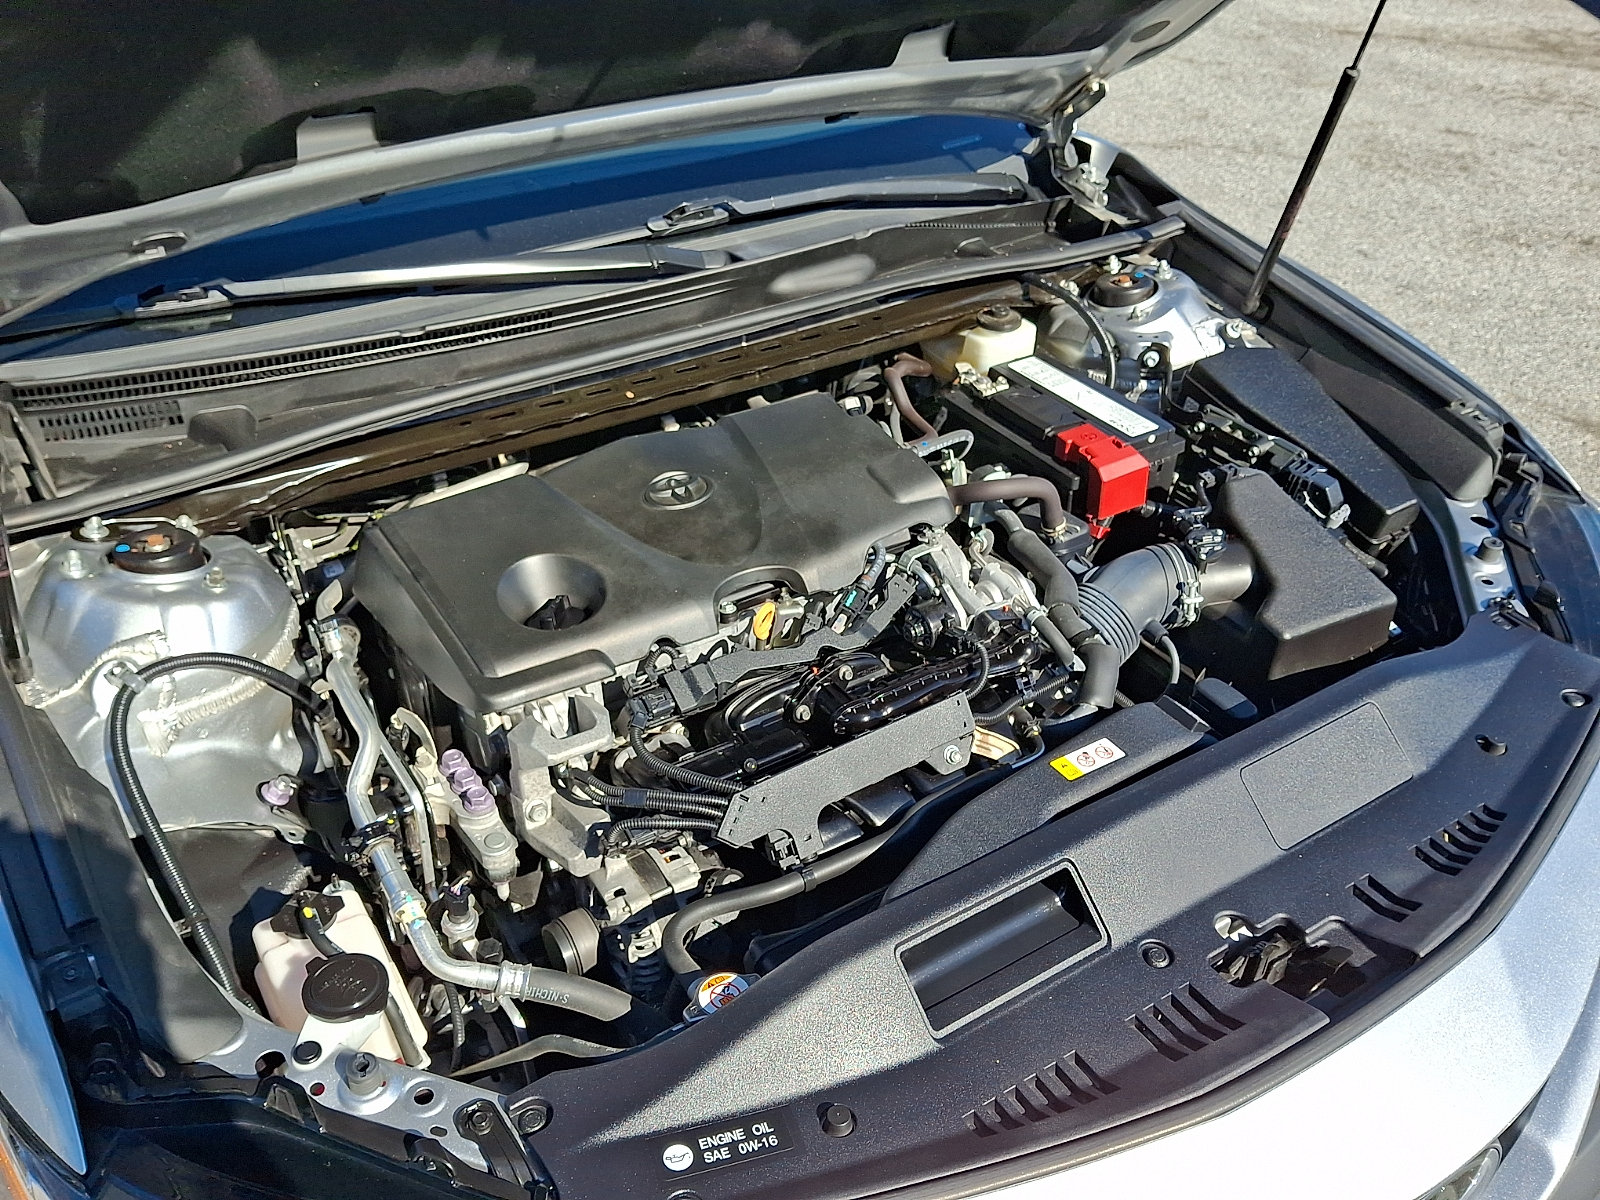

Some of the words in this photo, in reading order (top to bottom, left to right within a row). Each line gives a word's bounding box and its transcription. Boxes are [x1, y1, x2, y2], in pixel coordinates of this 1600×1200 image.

[698, 1128, 746, 1150] ENGINE
[752, 1122, 774, 1136] OIL
[703, 1147, 732, 1163] SAE
[738, 1135, 778, 1155] 0W-16
